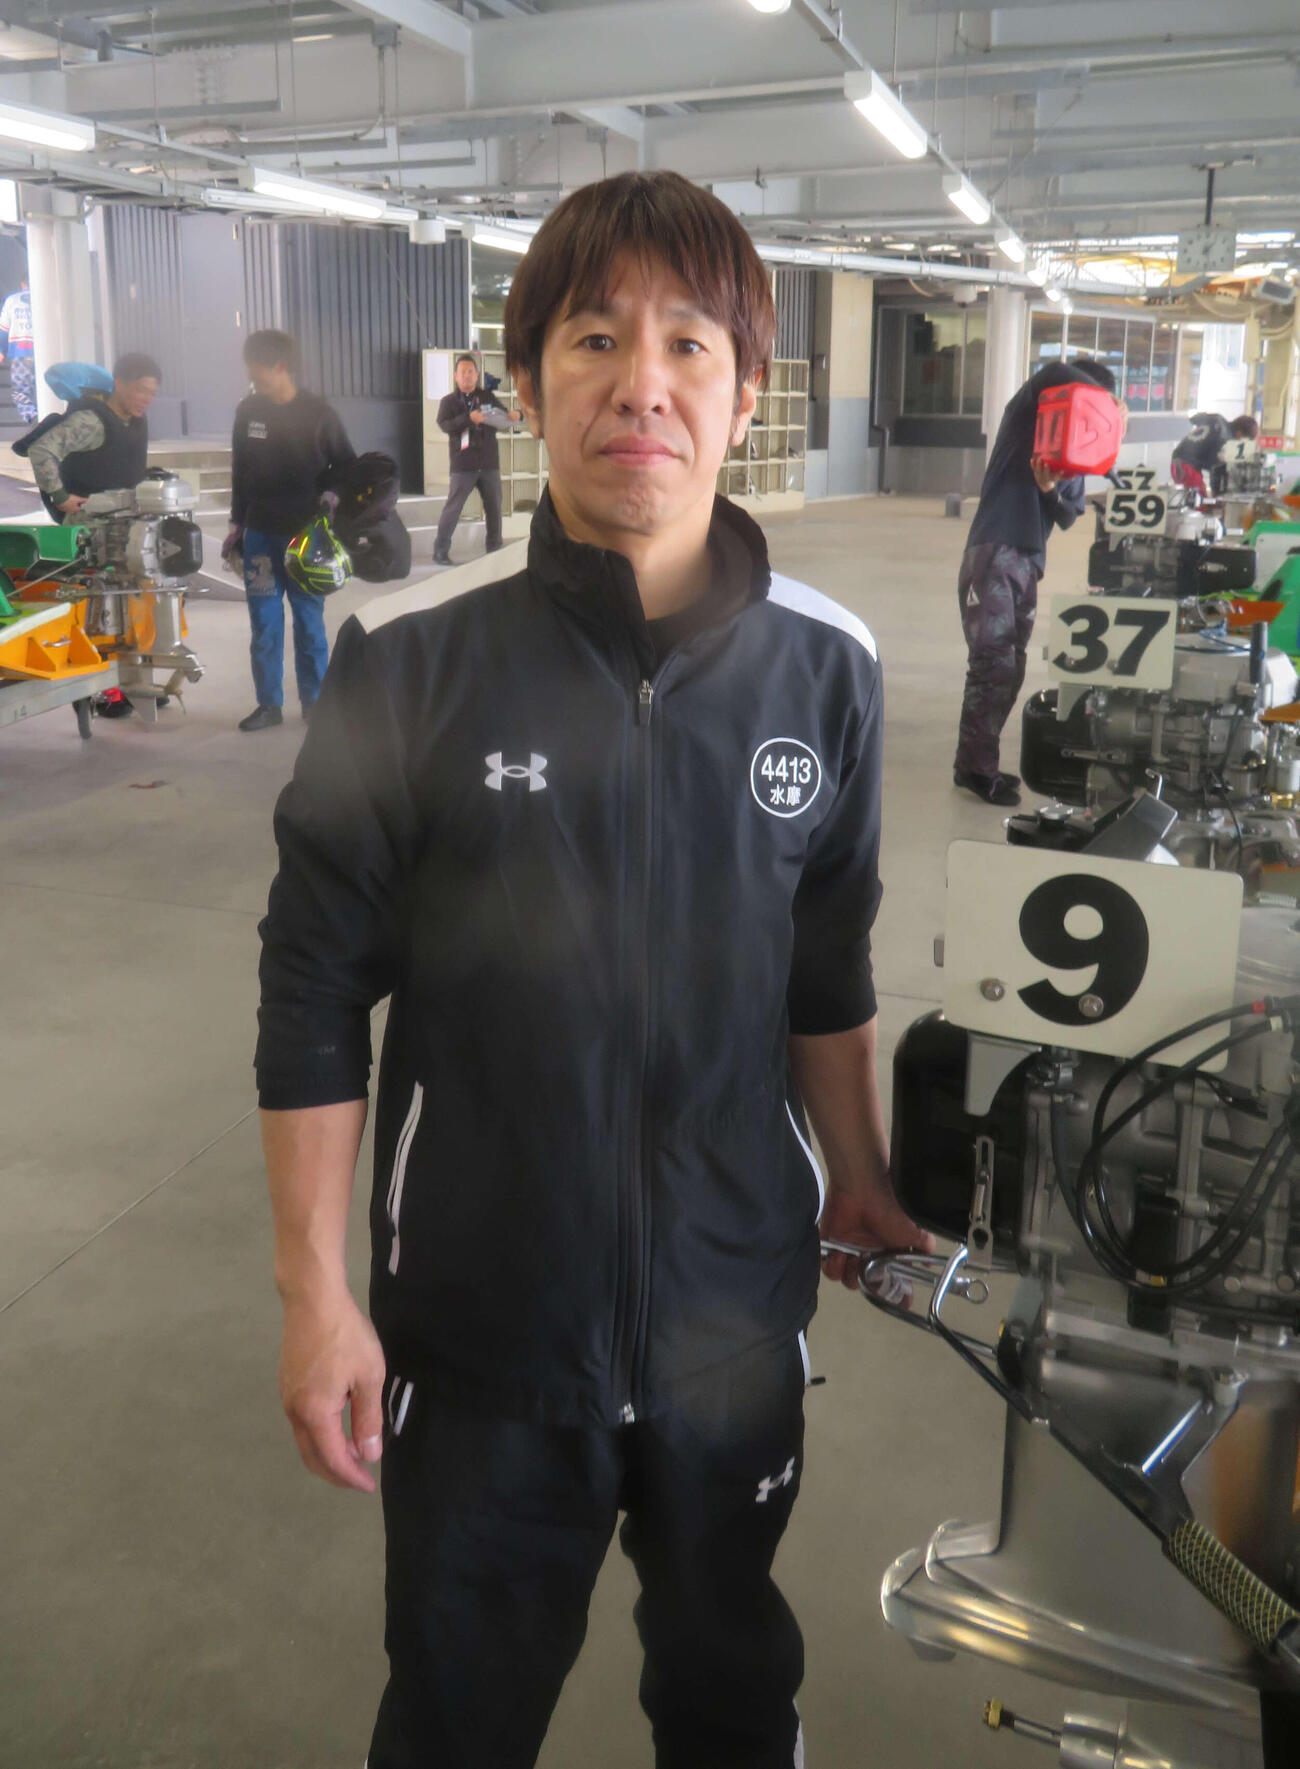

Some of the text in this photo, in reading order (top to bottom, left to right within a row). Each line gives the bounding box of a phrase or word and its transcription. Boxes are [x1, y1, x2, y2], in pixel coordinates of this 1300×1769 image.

[1235, 442, 1245, 460] 1
[1108, 494, 1165, 529] 59
[1052, 603, 1171, 677] 37
[761, 753, 811, 784] 4413
[1016, 873, 1150, 1026] 9
